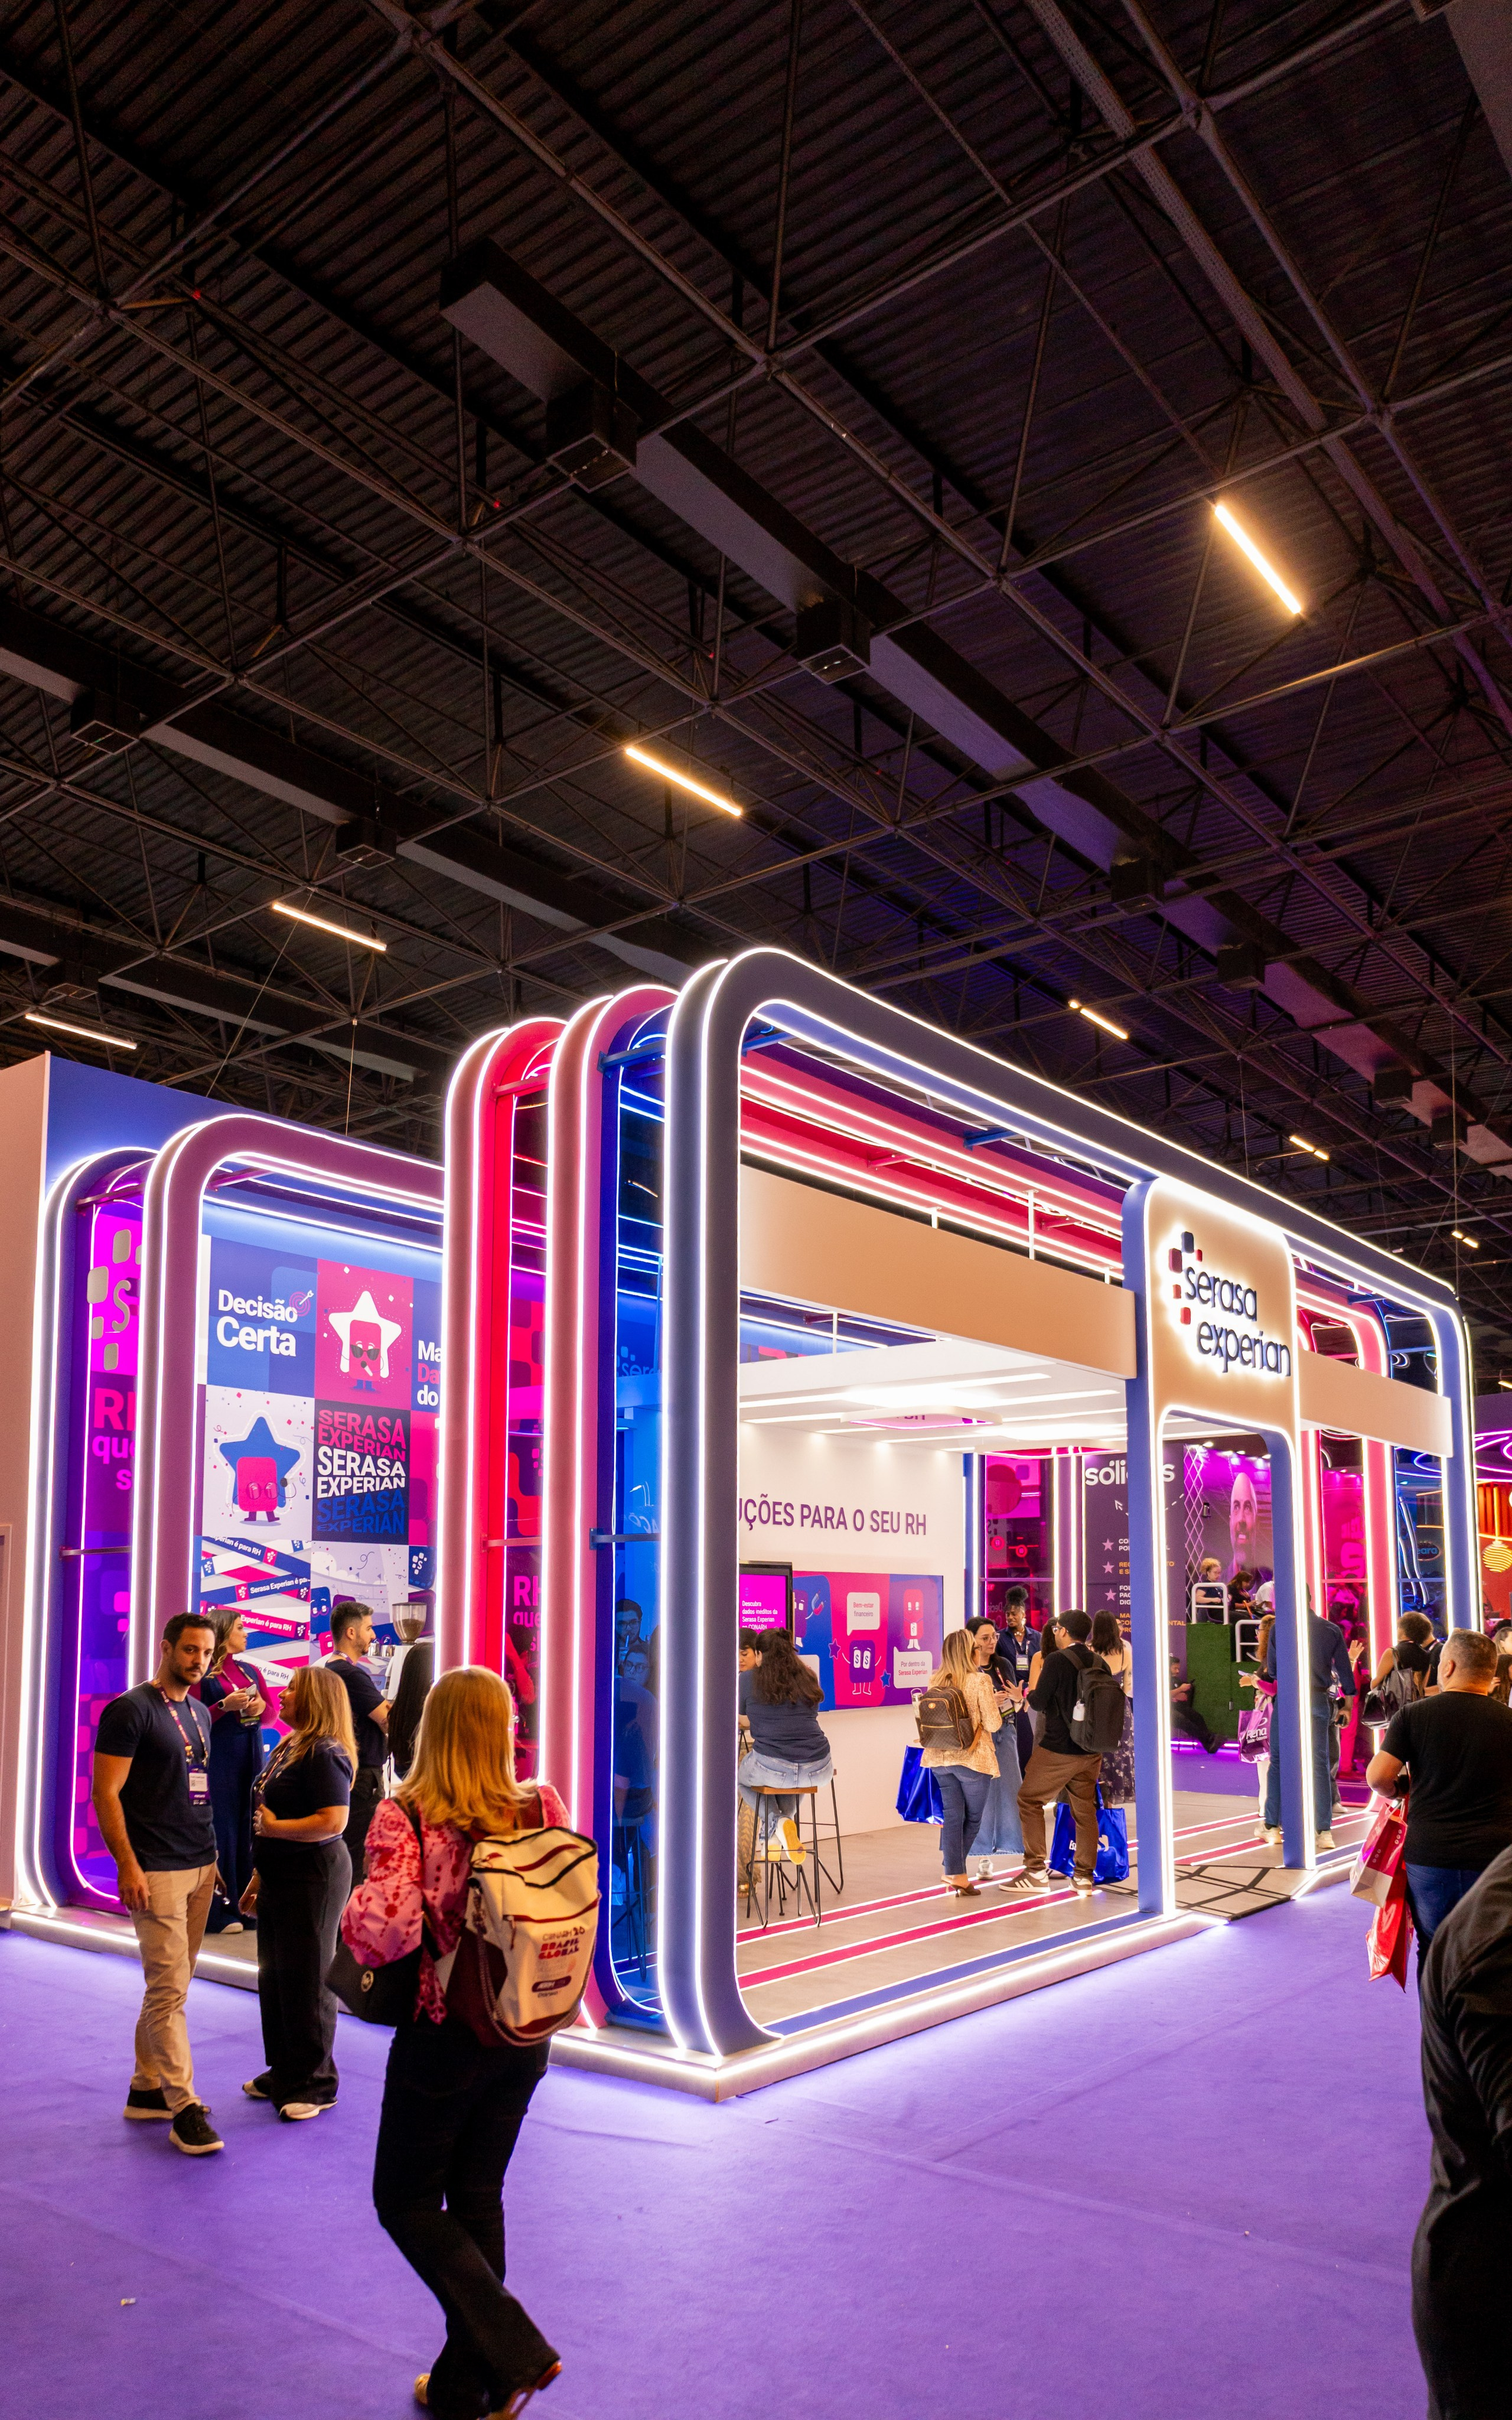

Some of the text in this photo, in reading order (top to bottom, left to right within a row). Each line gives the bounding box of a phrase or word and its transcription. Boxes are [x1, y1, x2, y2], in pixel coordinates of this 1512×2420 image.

[218, 1289, 298, 1323] Decisão
[1184, 1266, 1257, 1322] serasa
[216, 1315, 296, 1357] Certa
[1196, 1321, 1291, 1377] experian
[318, 1409, 406, 1449] SERASA
[318, 1423, 406, 1462] EXPERIAN
[317, 1445, 406, 1477] SERASA
[317, 1476, 406, 1499] EXPERIAN
[317, 1489, 405, 1523] SERASA
[800, 1504, 848, 1530] PARA
[853, 1508, 865, 1532] O
[870, 1510, 901, 1534] SEU
[905, 1512, 926, 1536] RH
[317, 1510, 405, 1535] EXPERIAN
[238, 1543, 252, 1552] para
[252, 1547, 262, 1556] RH
[250, 1585, 270, 1594] Serasa
[270, 1580, 294, 1590] Experian
[240, 1615, 265, 1626] Experian
[283, 1624, 292, 1632] RH
[539, 1946, 579, 1960] GLOBAL
